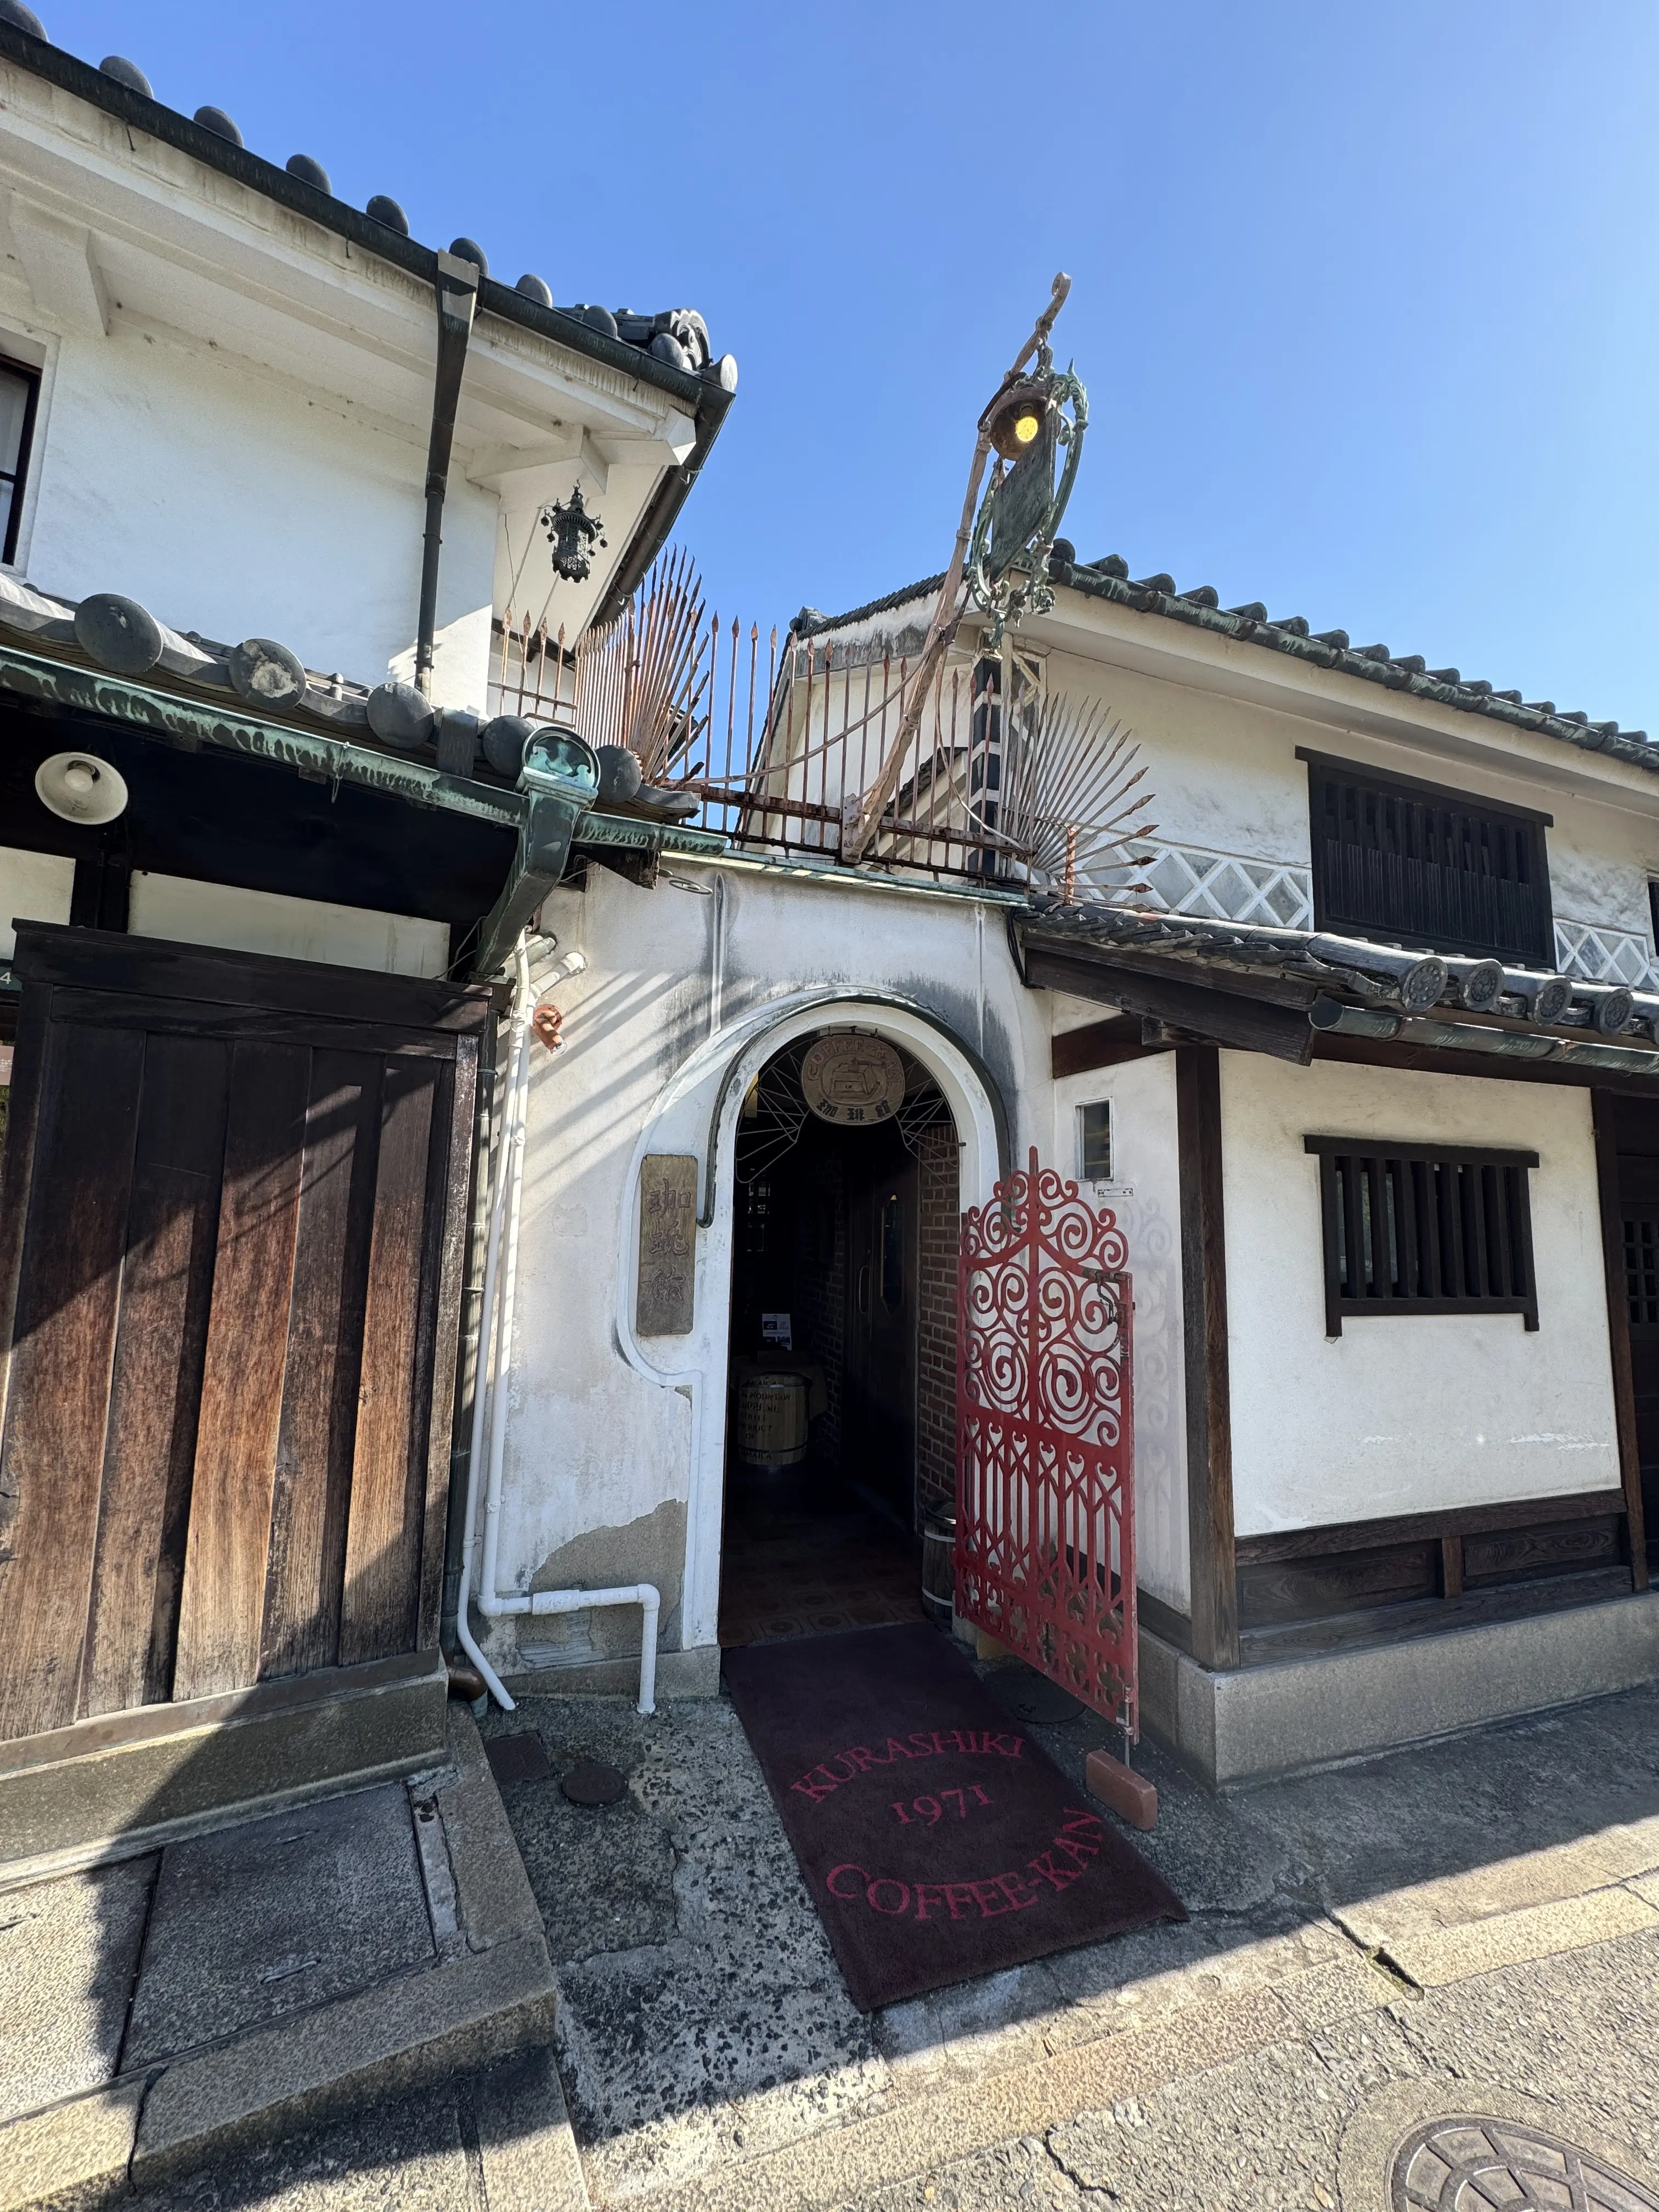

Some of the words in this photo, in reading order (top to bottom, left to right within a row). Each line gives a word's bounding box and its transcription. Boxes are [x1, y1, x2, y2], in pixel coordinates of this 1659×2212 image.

[808, 1039, 901, 1082] COFFEE-KAN
[791, 1730, 1026, 1803] KURASHIKI
[891, 1784, 995, 1826] 1971
[826, 1807, 1103, 1920] COFFEE-KAN
